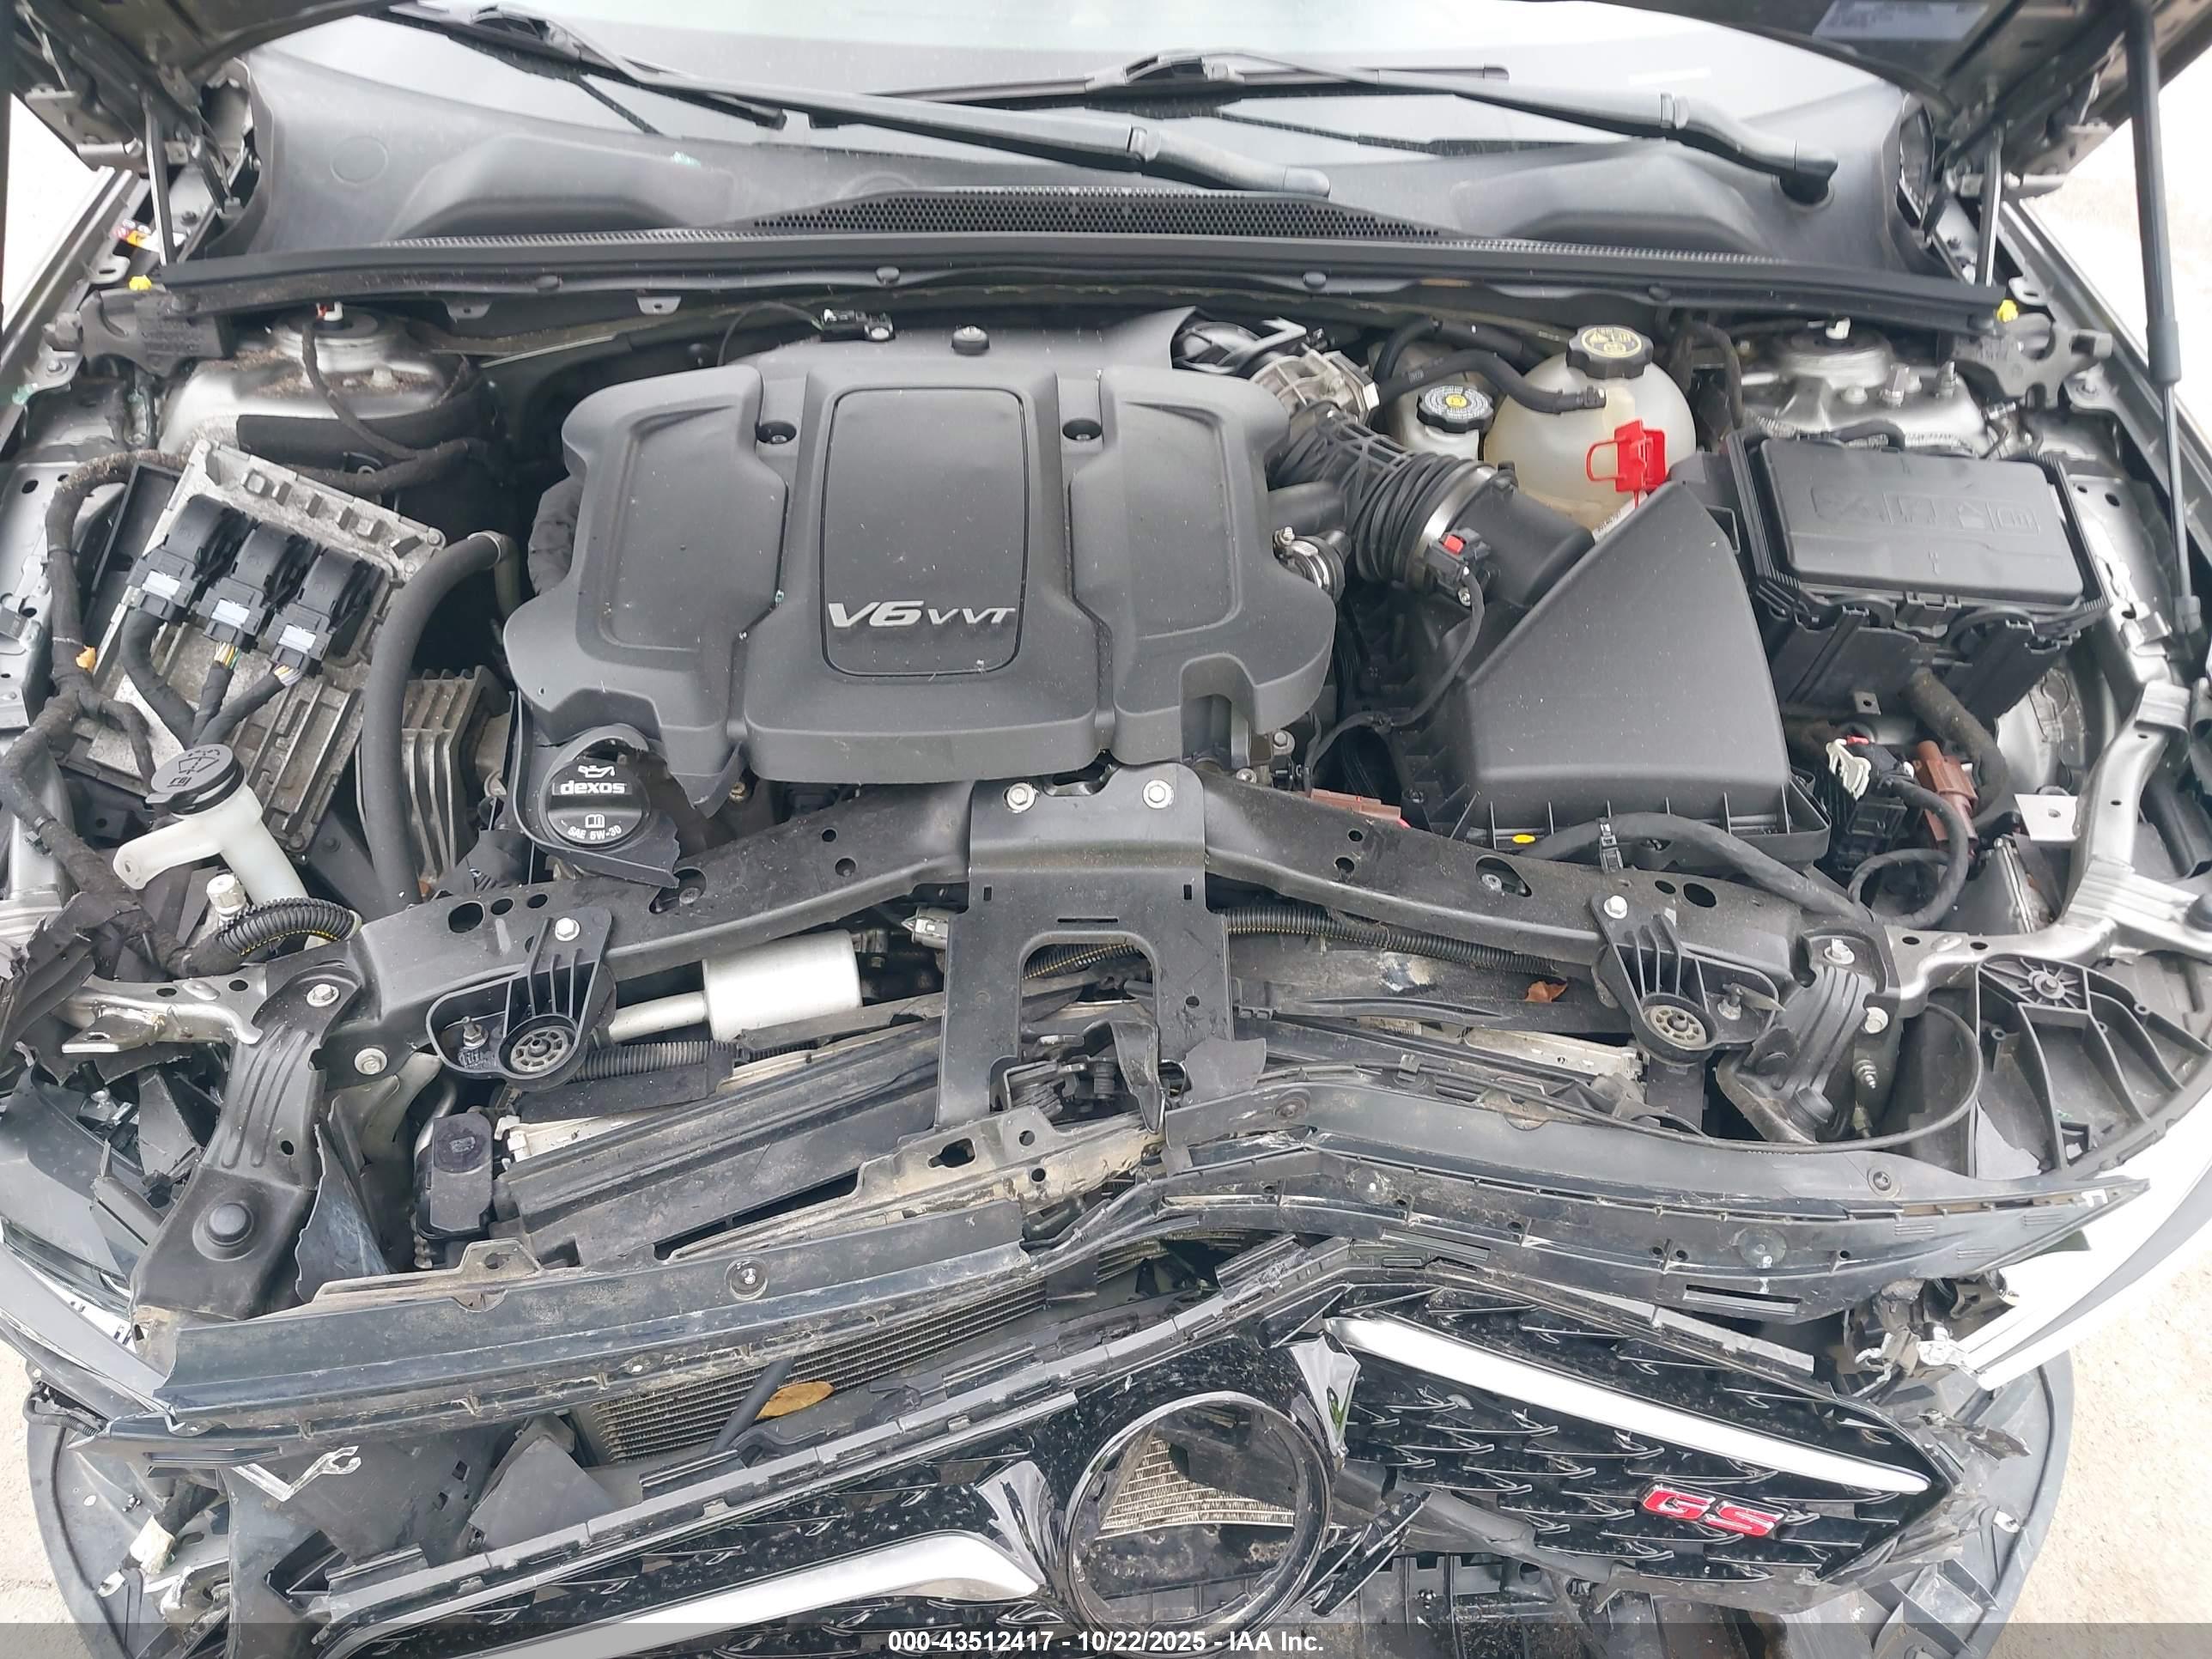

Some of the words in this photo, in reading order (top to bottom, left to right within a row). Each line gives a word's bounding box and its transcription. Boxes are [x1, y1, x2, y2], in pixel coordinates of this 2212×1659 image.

[829, 600, 924, 628] V6
[927, 608, 1016, 625] VVT
[560, 780, 628, 795] dexos
[568, 825, 586, 840] SAE
[589, 824, 623, 841] 5W-30
[1643, 1483, 1784, 1537] GS
